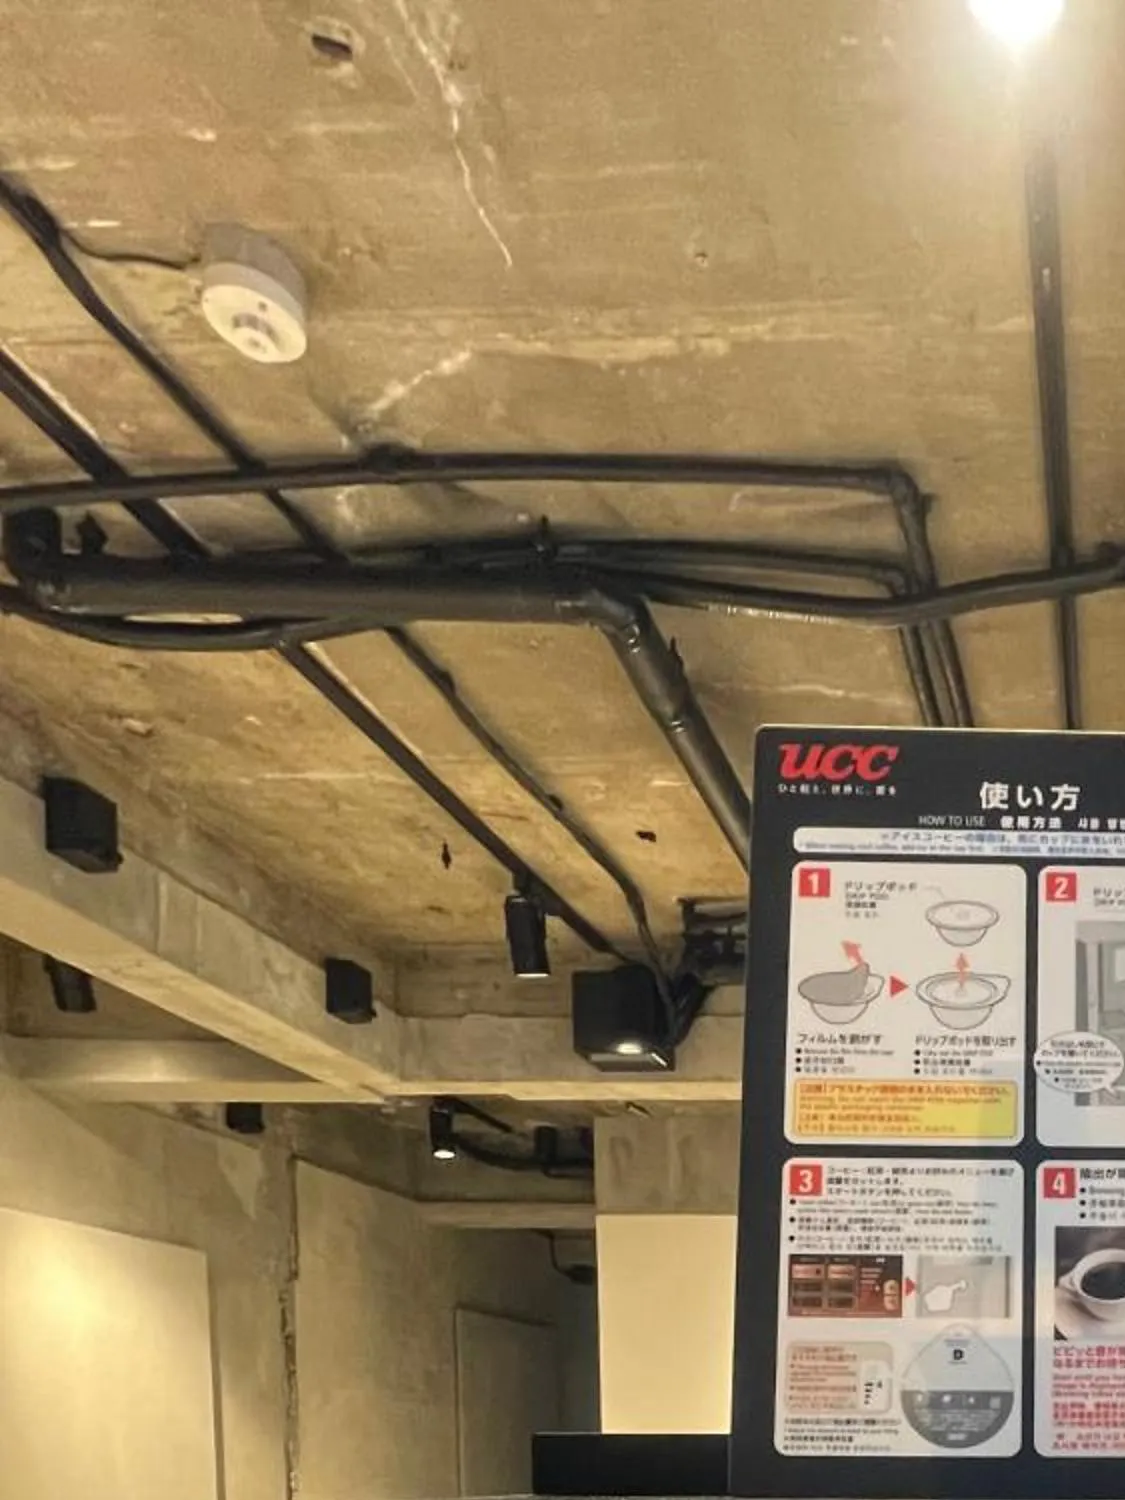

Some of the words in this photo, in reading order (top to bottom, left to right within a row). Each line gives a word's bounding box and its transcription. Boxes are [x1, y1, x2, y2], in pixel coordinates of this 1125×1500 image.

[979, 780, 1081, 811] 使い方
[918, 815, 945, 825] HOW
[949, 815, 963, 826] TO
[965, 816, 985, 826] USE
[806, 872, 821, 894] 1
[1053, 876, 1069, 899] 2
[798, 1168, 813, 1193] 3
[1051, 1171, 1066, 1196] 4
